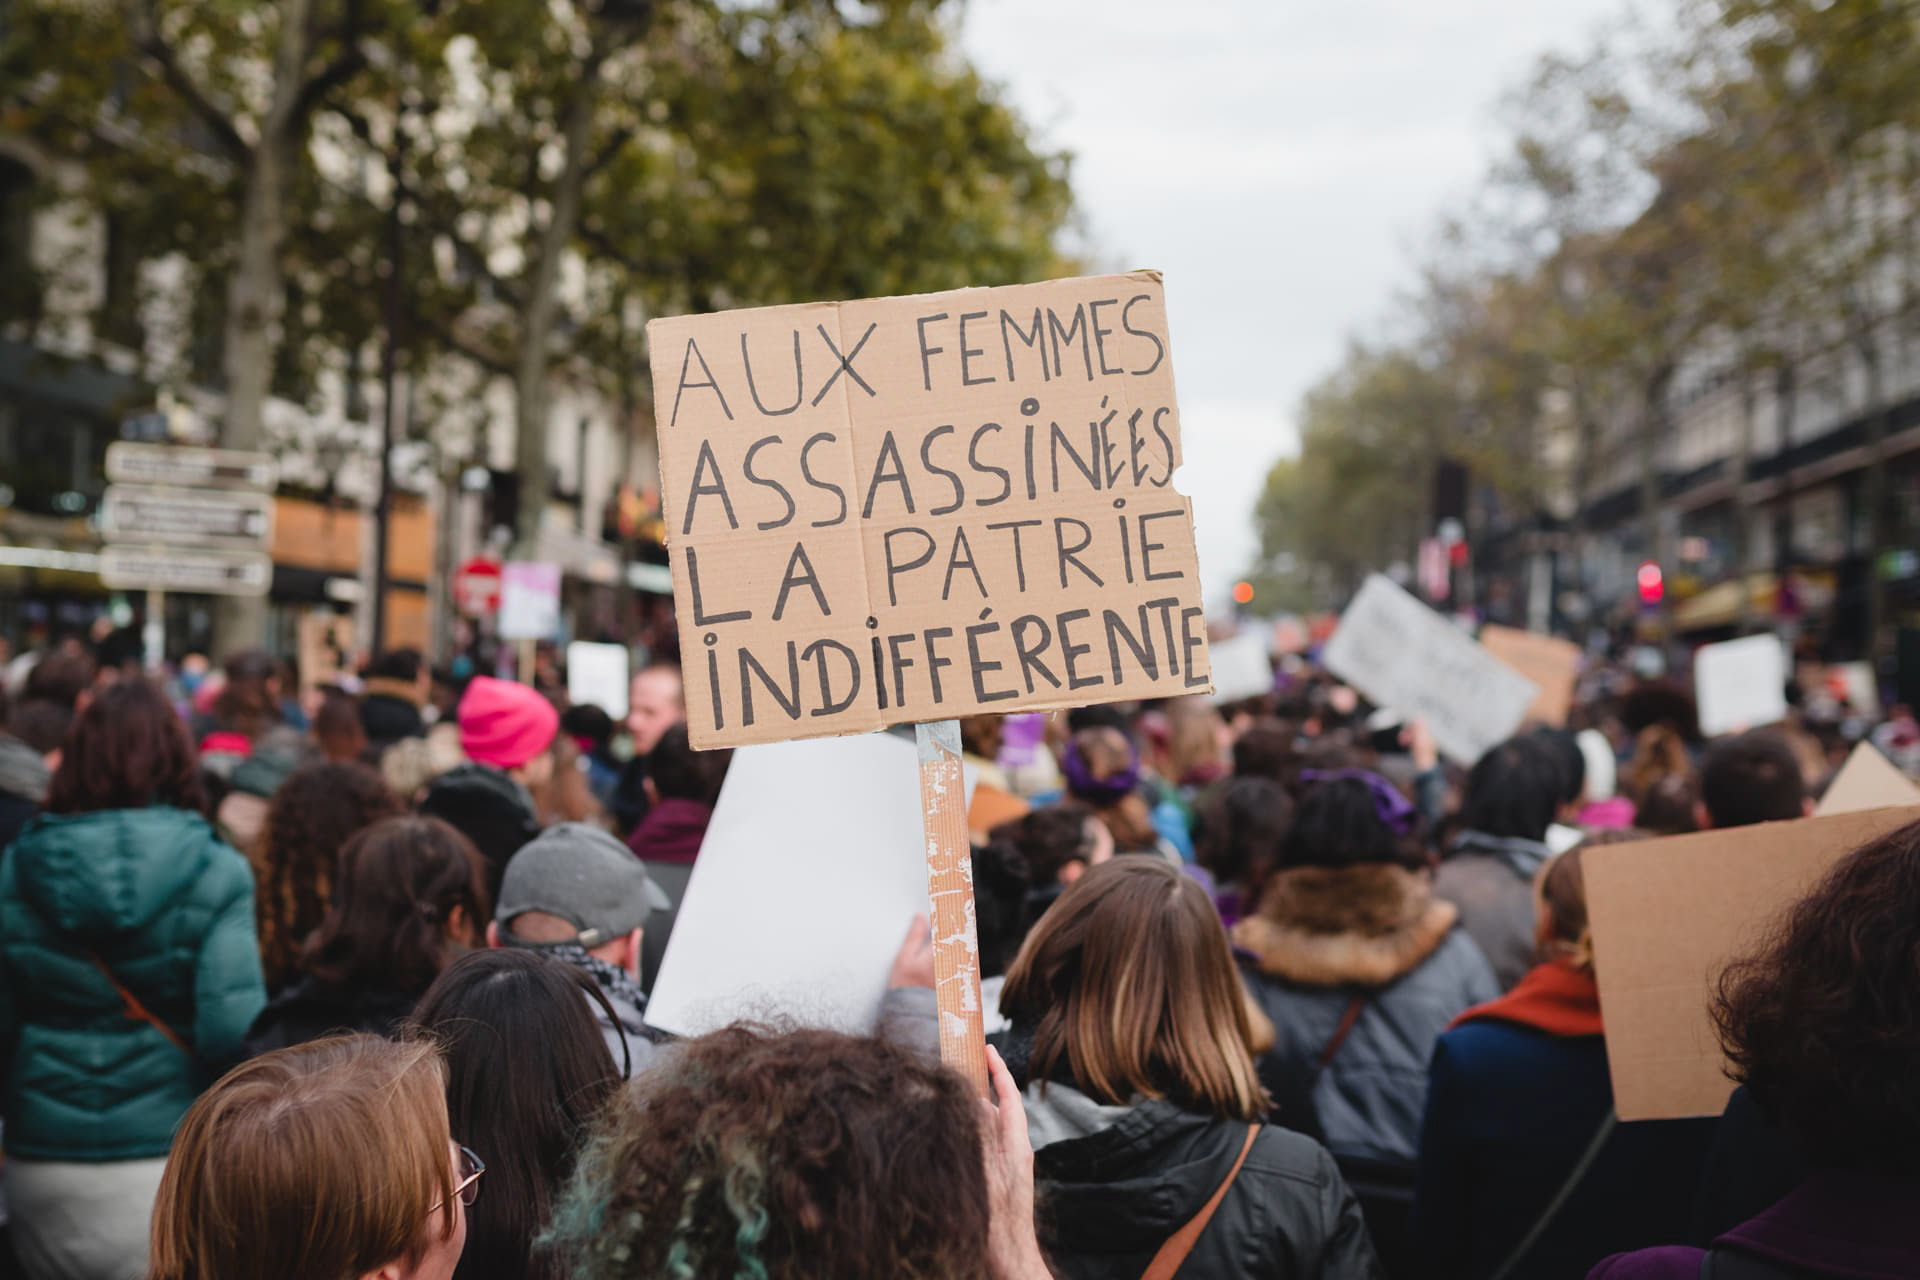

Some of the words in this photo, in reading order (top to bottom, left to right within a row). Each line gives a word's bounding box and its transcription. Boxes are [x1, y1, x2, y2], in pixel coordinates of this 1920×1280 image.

[670, 322, 877, 427] AUX
[917, 294, 1165, 391] FEMMES
[684, 541, 832, 627] LA
